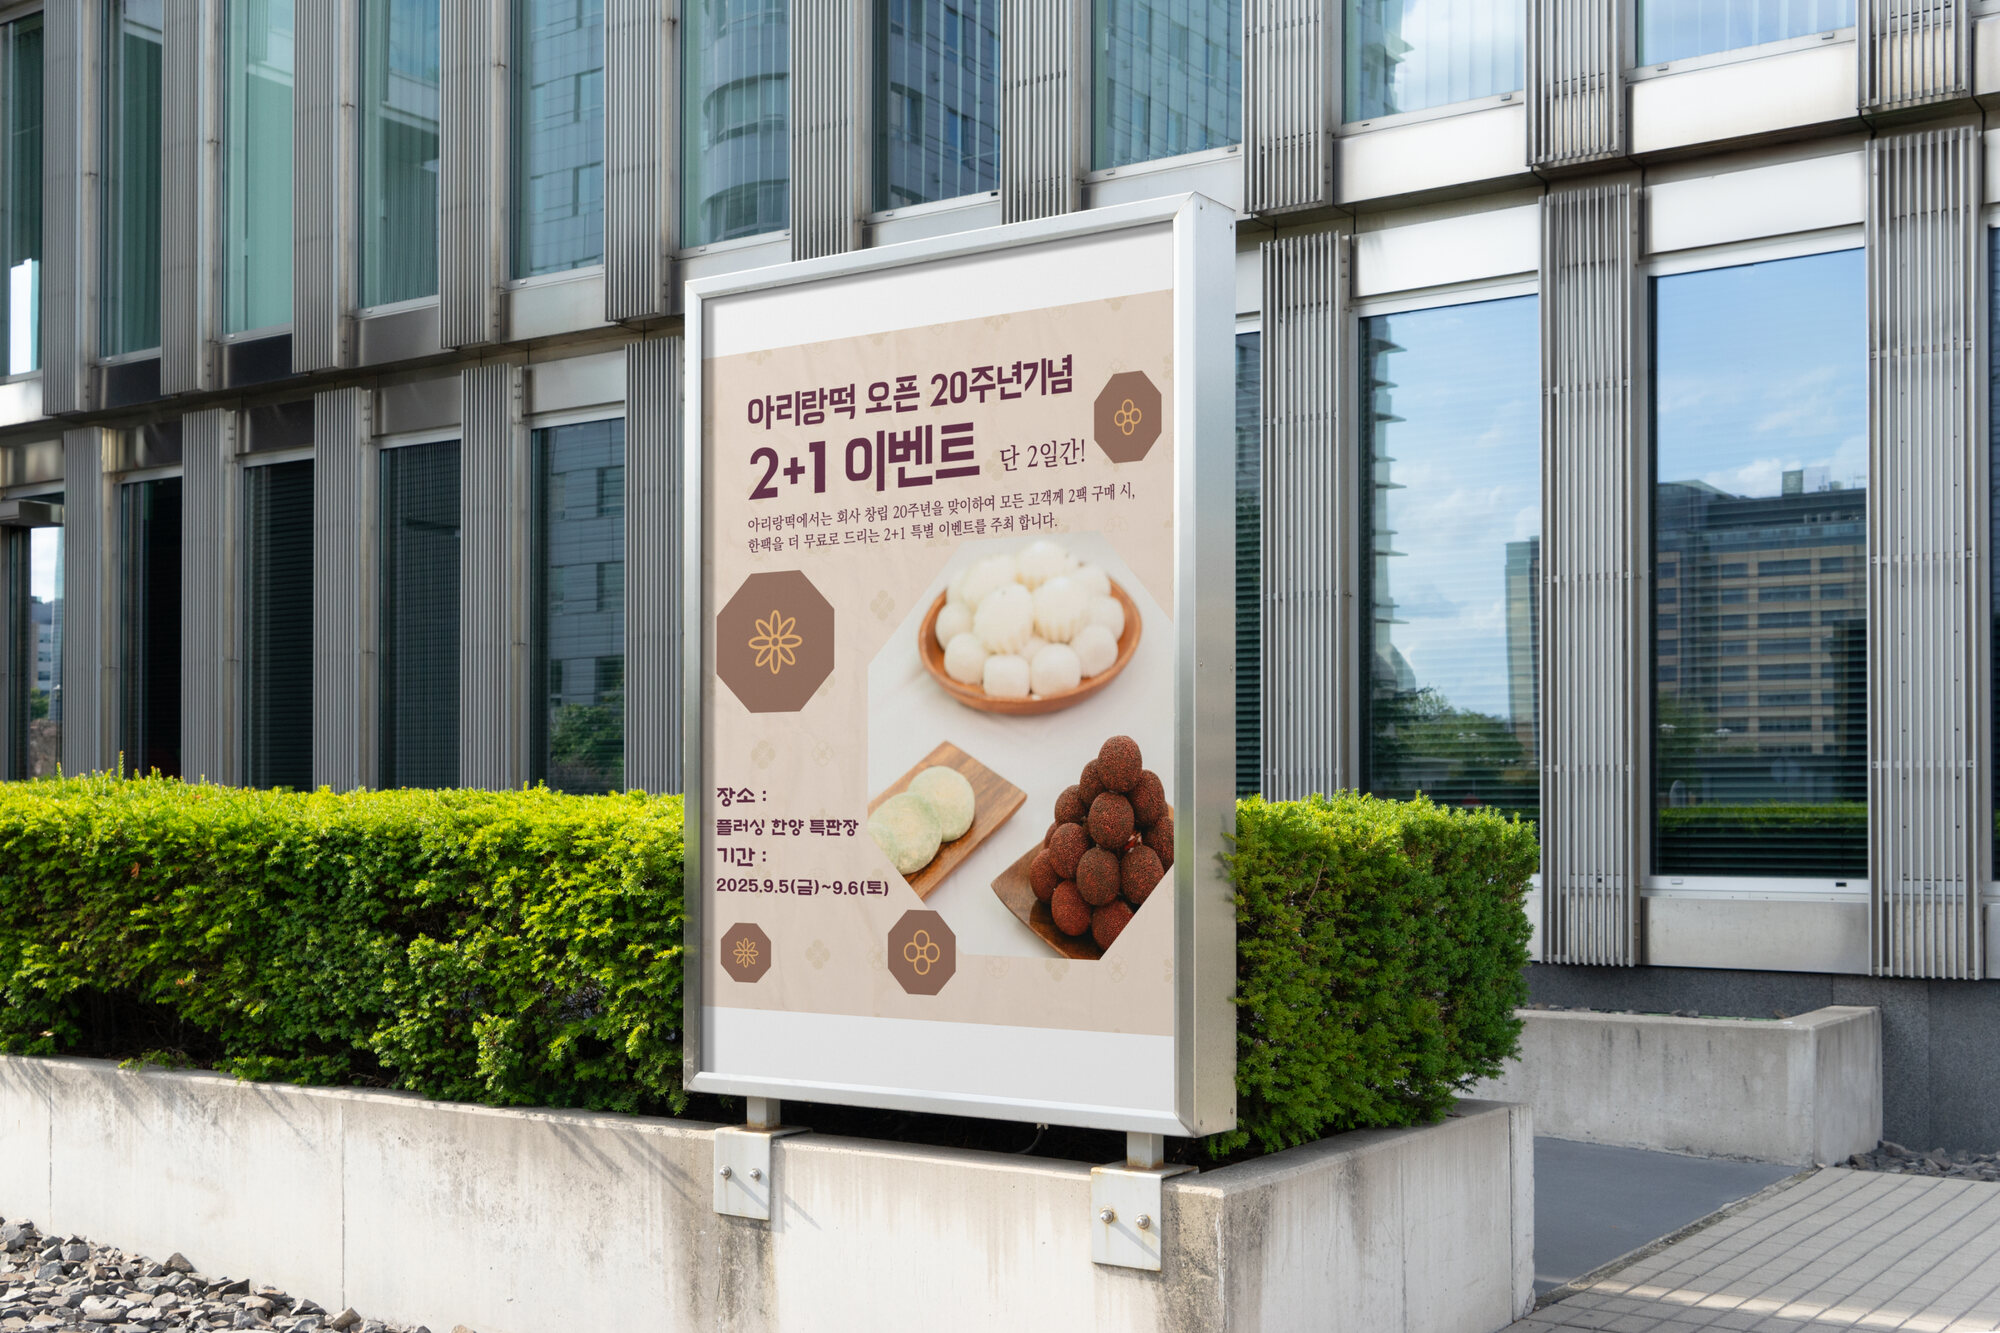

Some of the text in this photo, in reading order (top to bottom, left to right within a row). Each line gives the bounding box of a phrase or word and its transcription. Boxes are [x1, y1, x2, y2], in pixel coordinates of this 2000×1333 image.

[747, 354, 1073, 430] 아리랑떡 오픈 20주년기념
[748, 422, 1085, 501] 2+1 이벤트 단 2일간!
[747, 482, 1136, 535] 아리랑떡에서는 회사 창립 20주년을 맞이하여 모든 고객께 2팩 구매 시,
[747, 512, 1058, 554] 한팩을 더 무료로 드리는 2+1 특별 이벤트를 주최 합니다.
[716, 787, 756, 808] 장소
[716, 819, 860, 837] 플러싱 한양 특판장
[716, 847, 756, 868] 기간
[716, 878, 889, 897] 2025.9.5(금)~9.6(토)
